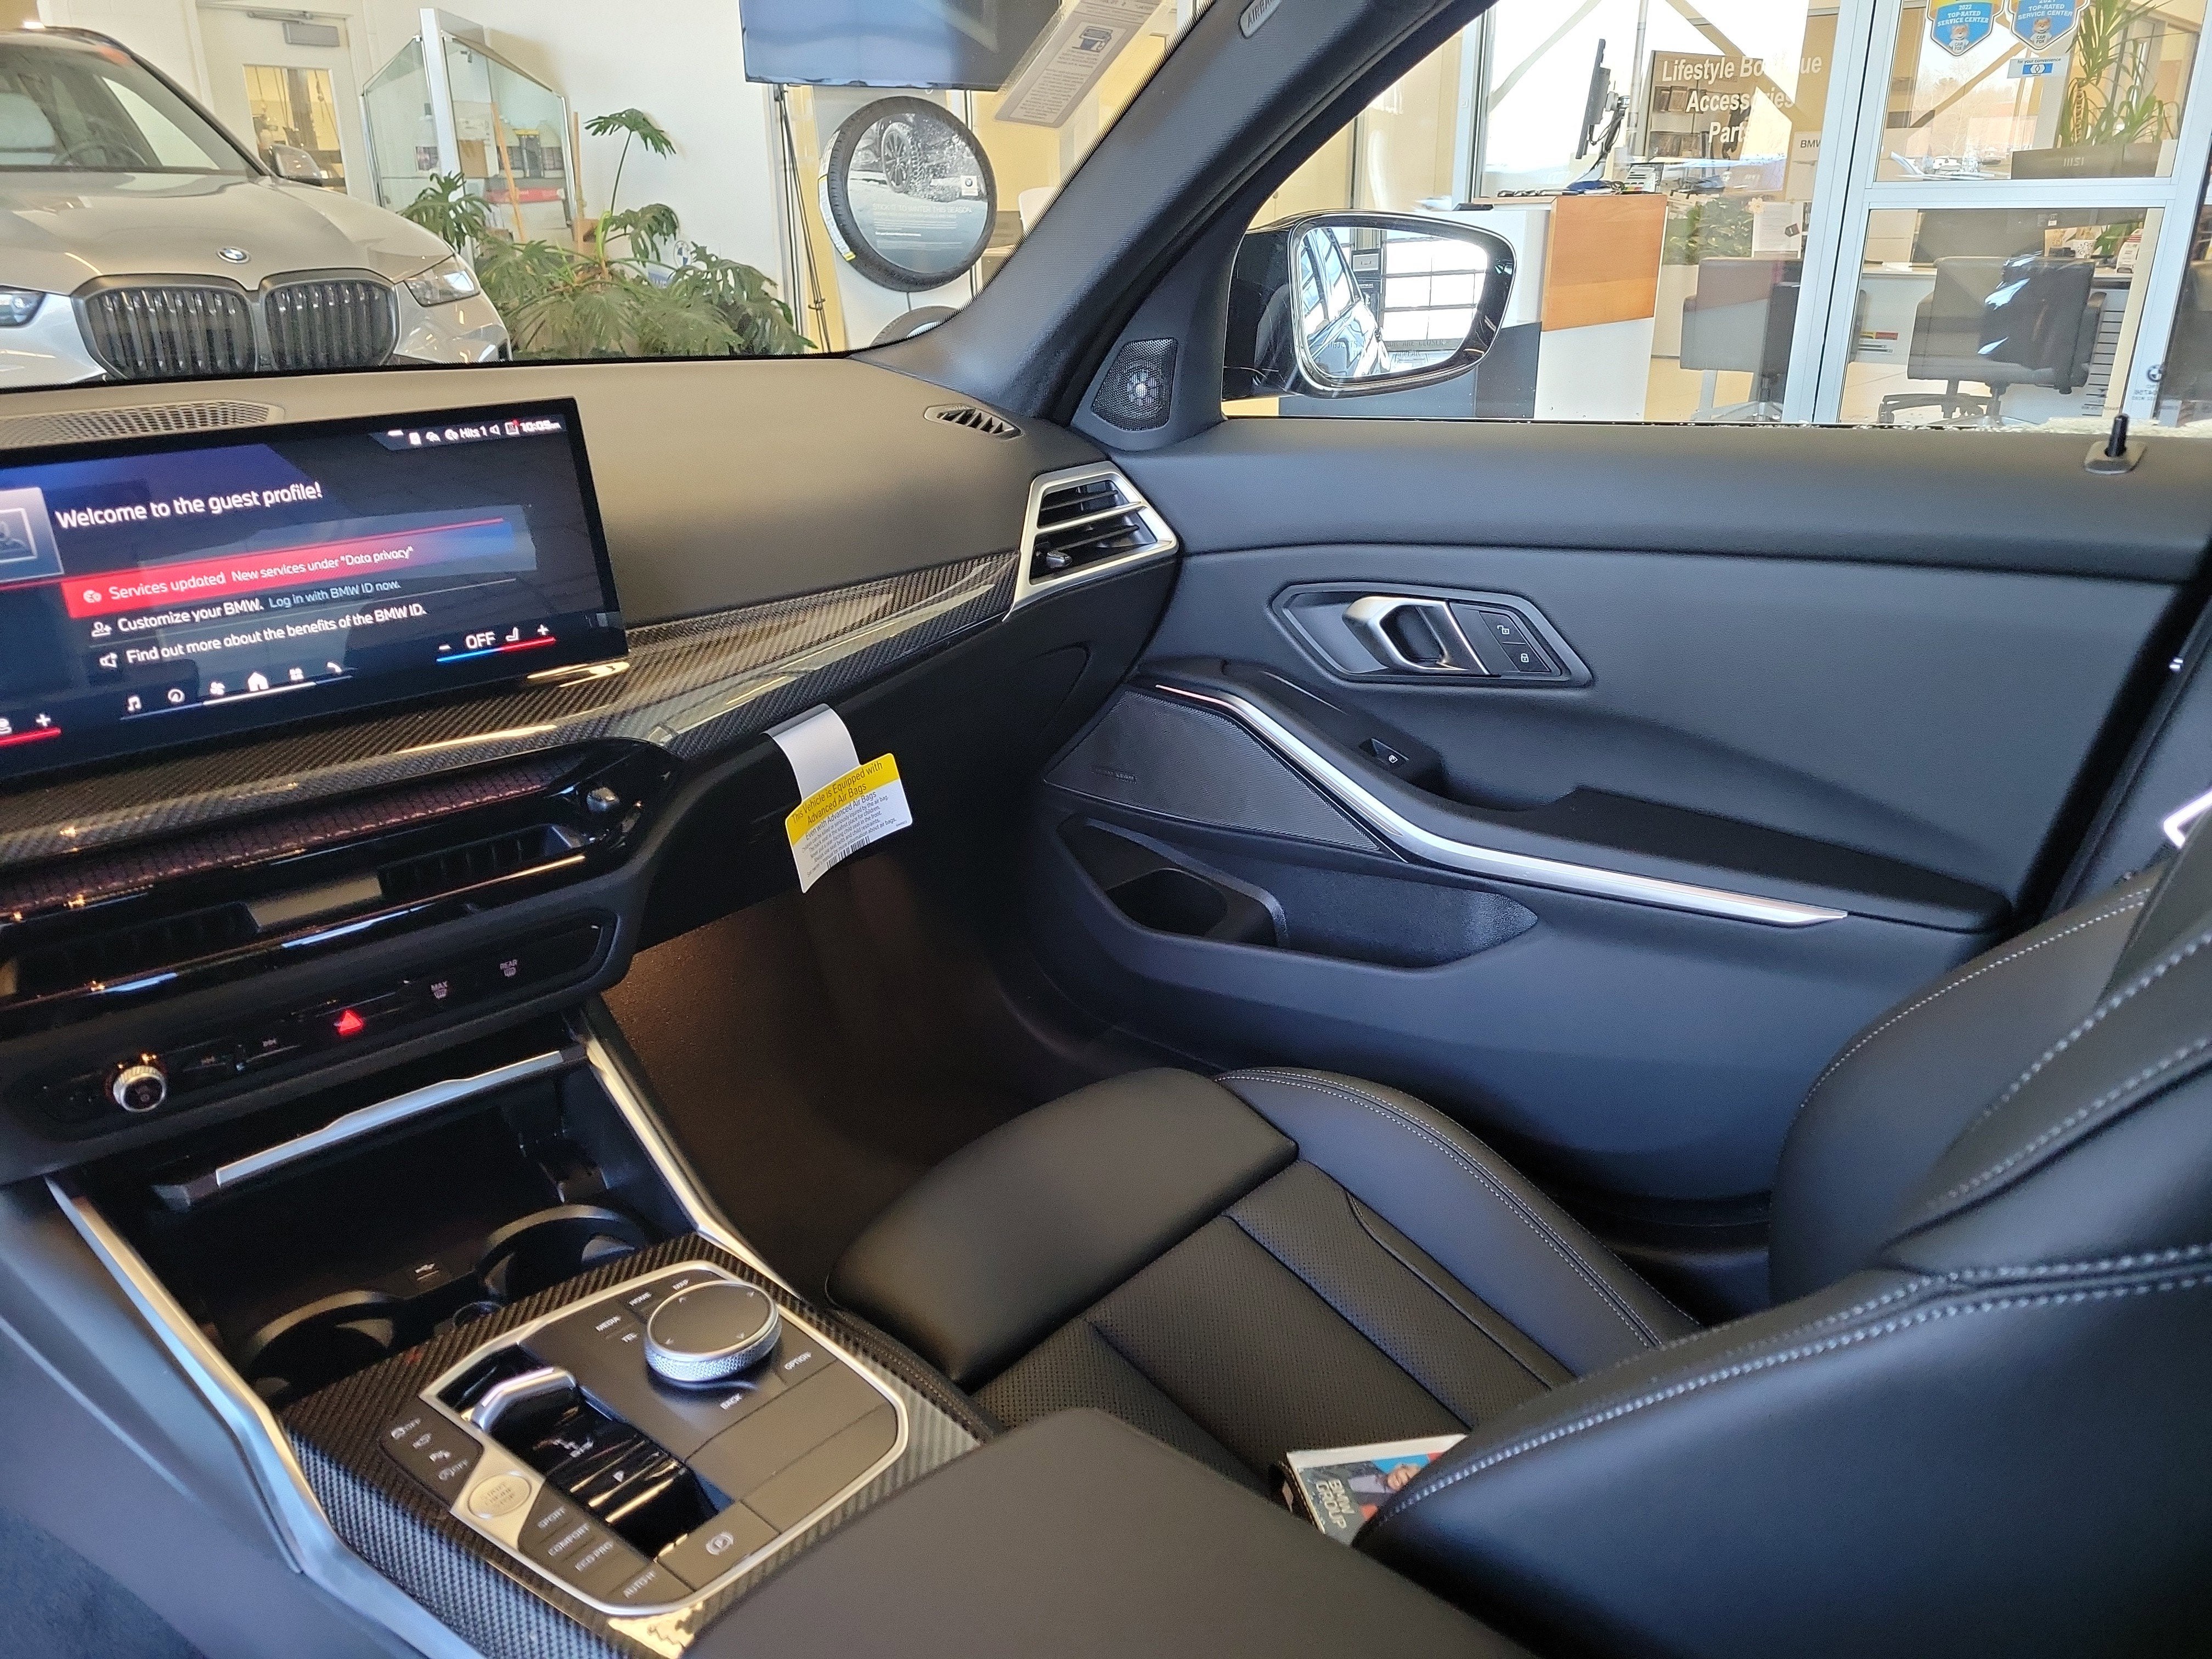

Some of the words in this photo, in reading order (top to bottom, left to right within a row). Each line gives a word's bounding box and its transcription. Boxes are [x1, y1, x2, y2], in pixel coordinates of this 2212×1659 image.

[1938, 18, 1964, 27] SERVICE
[1662, 58, 1735, 85] Lifestyle
[459, 427, 481, 438] Hits
[55, 504, 147, 528] Welcome
[153, 501, 171, 517] to
[174, 496, 205, 516] the
[210, 490, 261, 514] guest
[263, 481, 323, 507] profile!
[231, 569, 258, 582] New
[262, 563, 307, 578] services
[307, 558, 339, 571] under
[109, 582, 168, 600] Services
[171, 571, 226, 592] updated
[269, 597, 291, 608] Log
[293, 594, 304, 605] in
[305, 589, 330, 602] with
[330, 584, 359, 598] BMW
[362, 582, 374, 594] ID
[375, 580, 401, 591] now.
[117, 612, 191, 631] Customize
[191, 606, 222, 623] your
[223, 598, 264, 616] BMW.
[126, 646, 160, 664] Find
[161, 644, 185, 658] out
[186, 639, 222, 654] more
[223, 630, 263, 648] about
[263, 628, 286, 641] the
[286, 619, 337, 637] benefits
[338, 614, 353, 628] of
[353, 613, 374, 627] the
[374, 605, 408, 622] BMW
[409, 603, 427, 617] ID.
[465, 631, 496, 650] OFF
[791, 810, 803, 823] This
[802, 793, 826, 814] Vehicle
[826, 788, 832, 798] is
[832, 769, 866, 794] Equipped
[866, 763, 883, 775] with
[809, 798, 837, 826] Advanced
[839, 794, 847, 805] Air
[848, 783, 867, 798] Bags
[805, 828, 816, 840] Even
[816, 820, 827, 831] with
[828, 803, 853, 824] Advanced
[861, 792, 877, 803] Bags
[785, 1351, 811, 1370] OPTION
